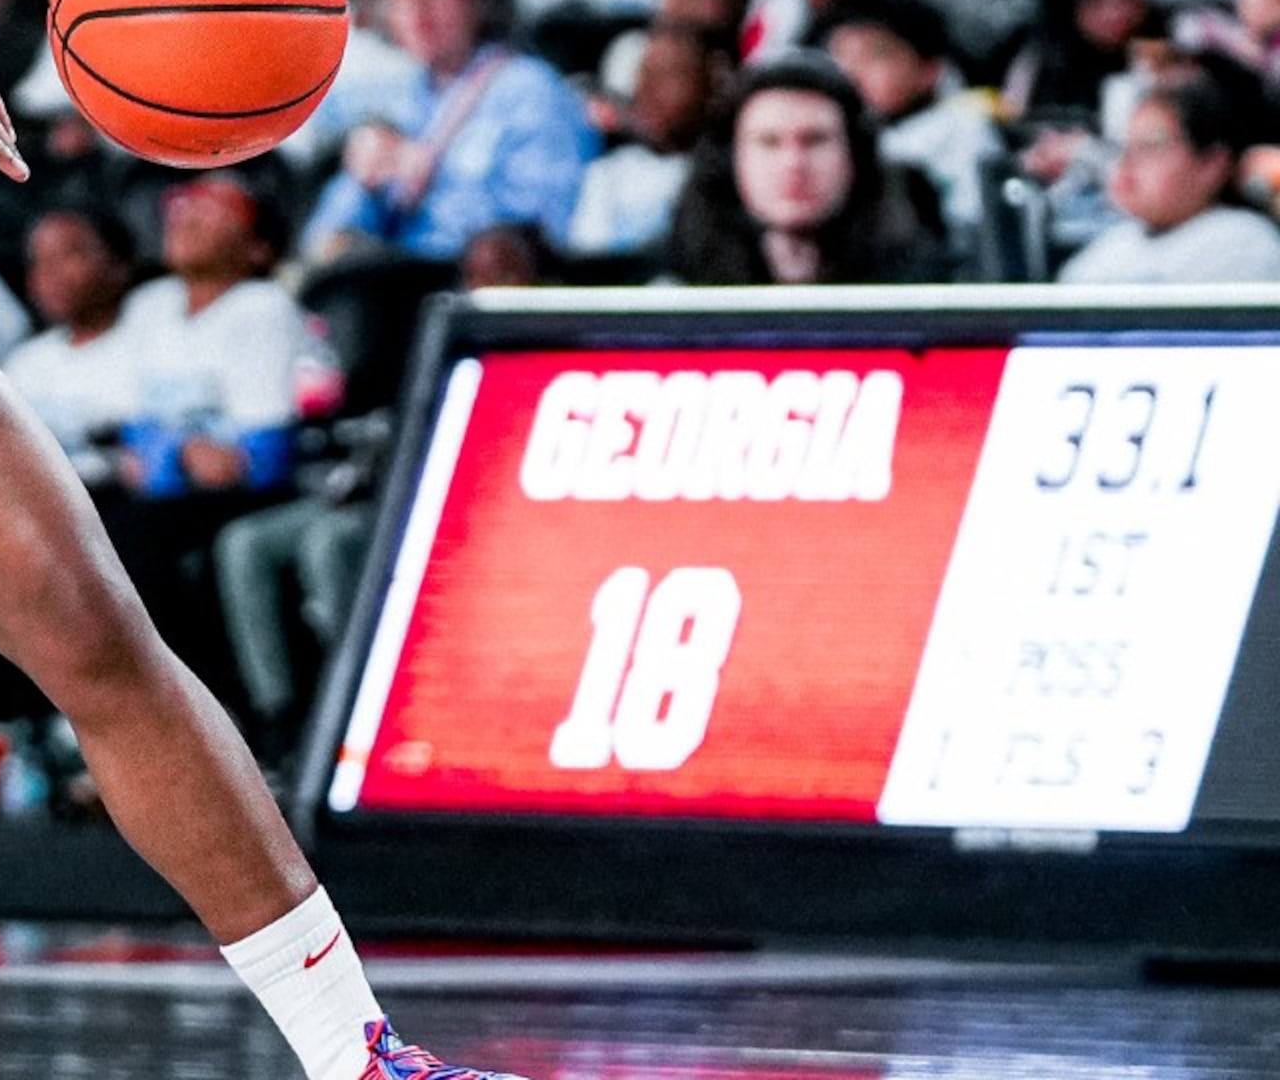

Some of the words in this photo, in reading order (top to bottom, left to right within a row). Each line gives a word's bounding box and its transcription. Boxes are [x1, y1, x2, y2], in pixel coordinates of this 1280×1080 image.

[519, 369, 904, 502] GEORGIA
[1034, 380, 1219, 493] 33.1
[1046, 529, 1151, 599] 1ST
[548, 565, 743, 770] 18
